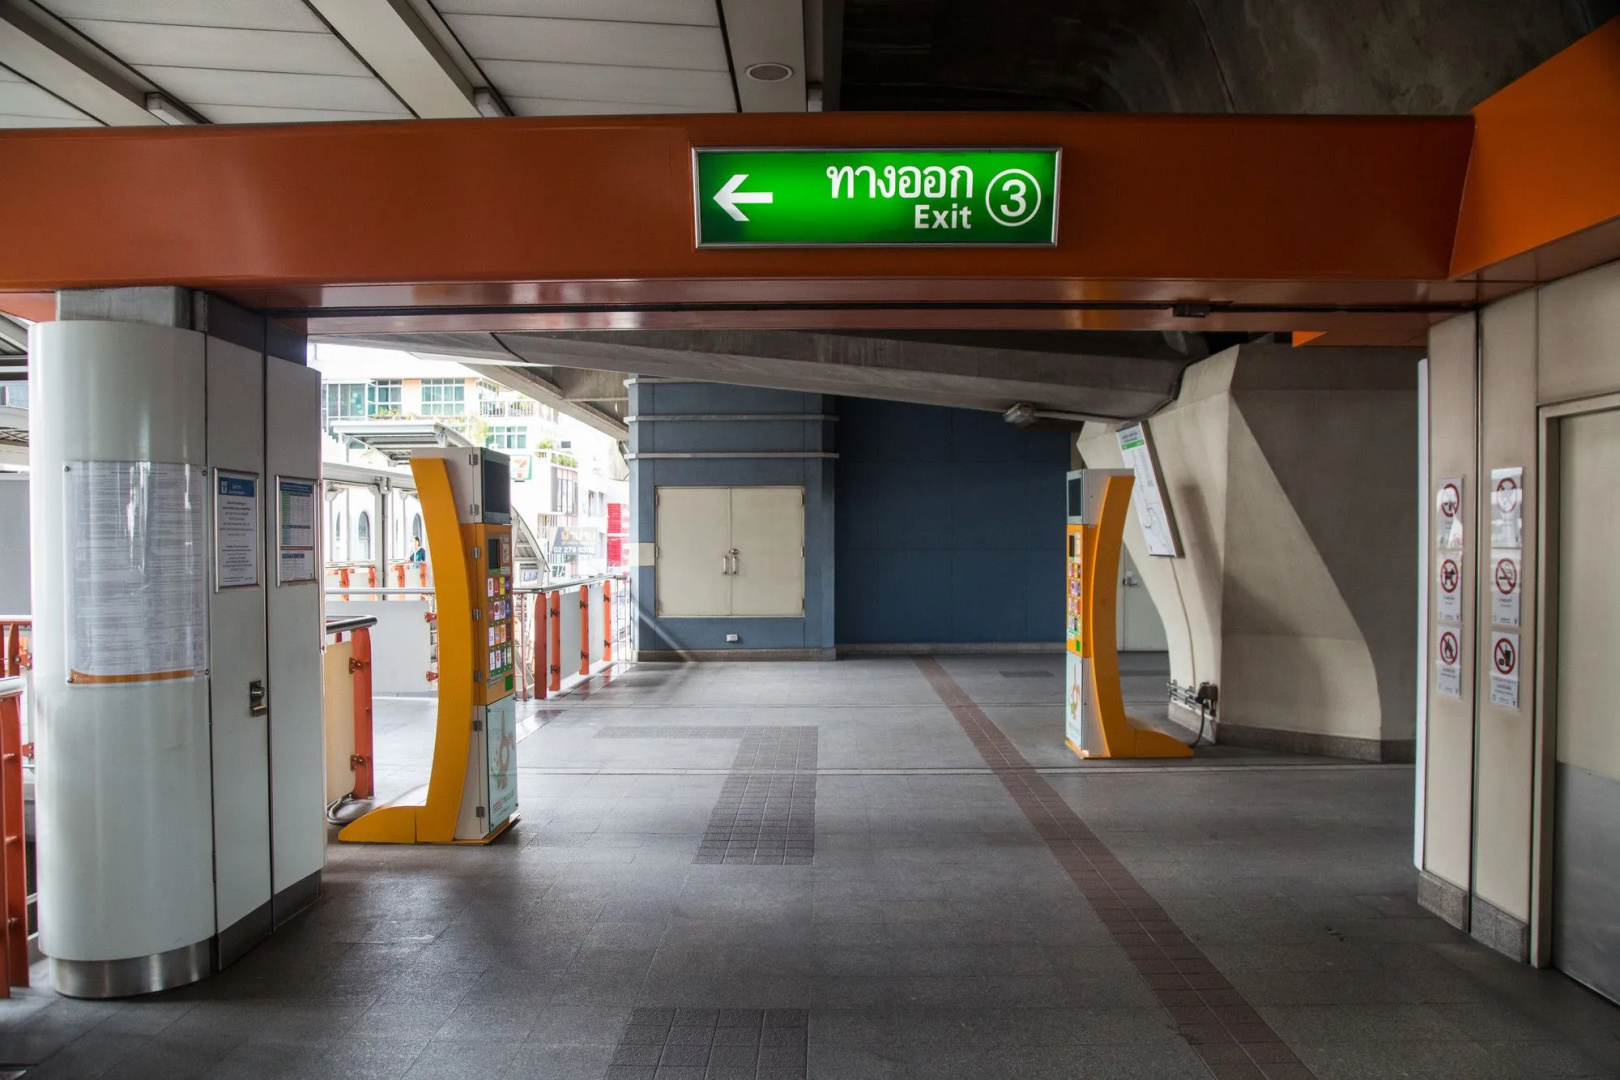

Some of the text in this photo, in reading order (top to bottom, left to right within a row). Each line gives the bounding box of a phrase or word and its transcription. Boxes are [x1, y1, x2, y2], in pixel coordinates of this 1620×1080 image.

[826, 165, 974, 199] ทางออก
[1000, 178, 1027, 217] 3
[914, 203, 972, 229] Exit
